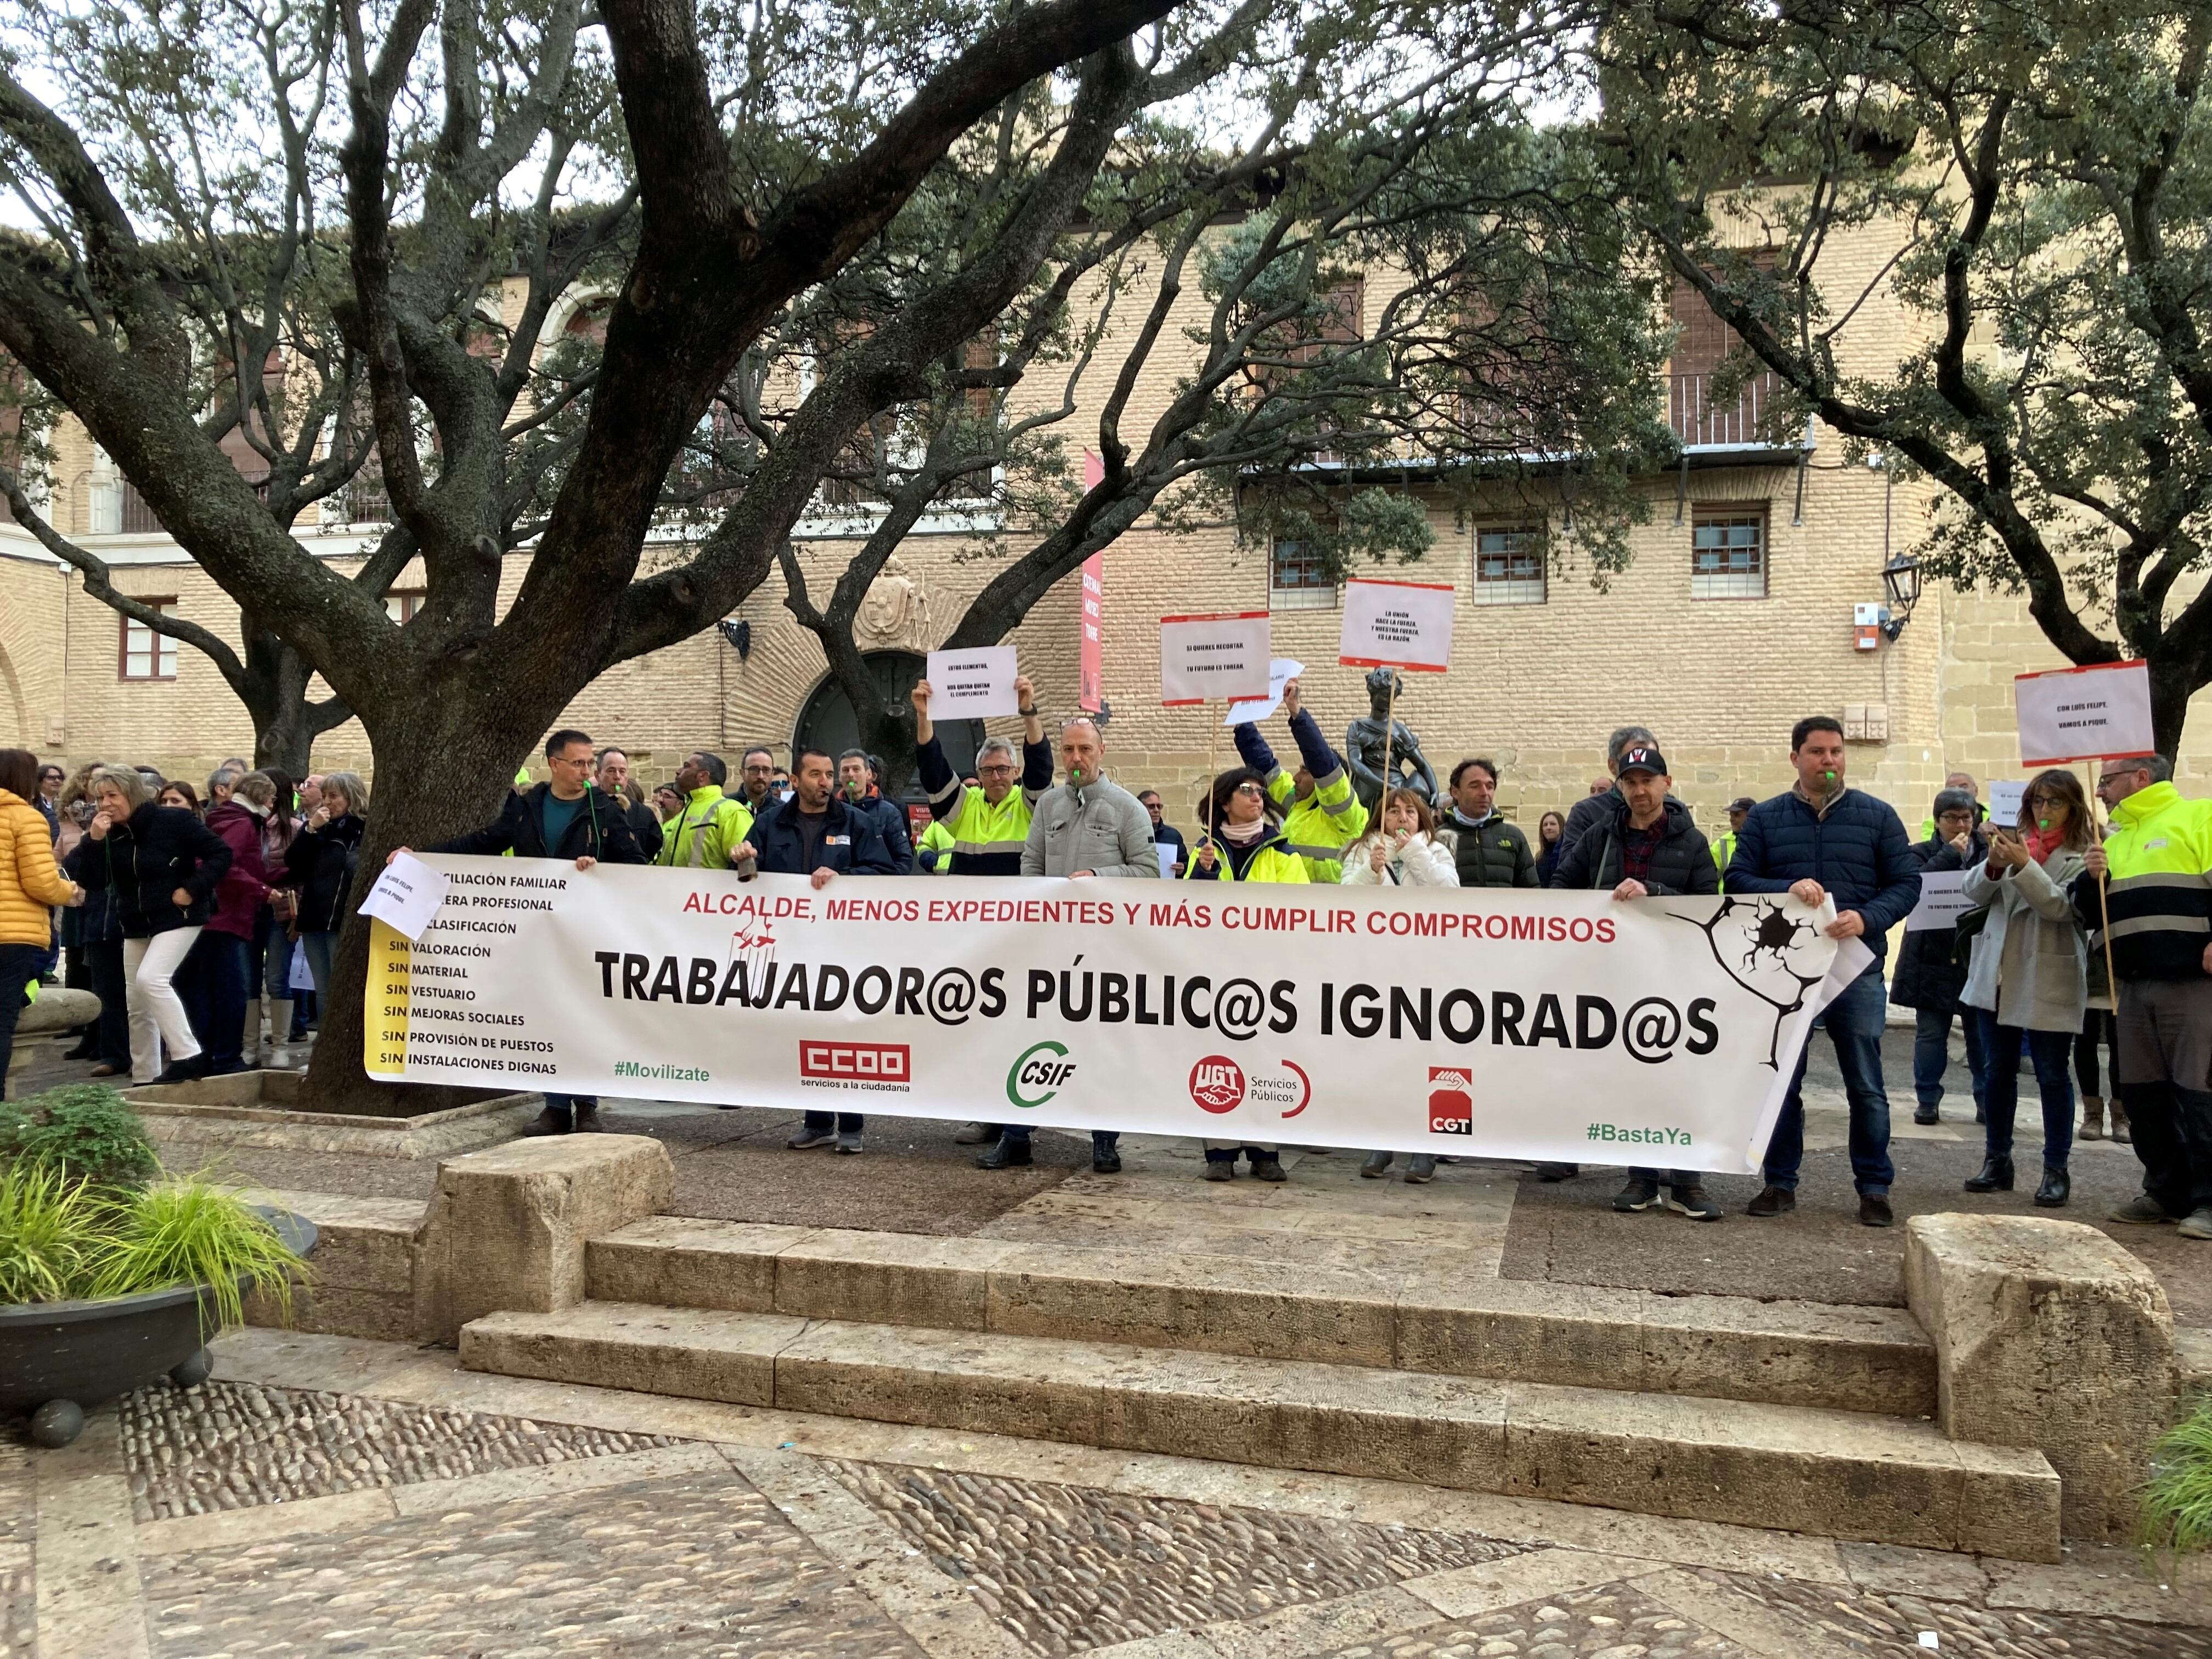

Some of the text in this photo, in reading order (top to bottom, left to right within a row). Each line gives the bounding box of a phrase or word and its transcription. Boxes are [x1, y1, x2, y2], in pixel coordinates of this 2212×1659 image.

[2058, 720, 2081, 729] VAMOS
[510, 876, 567, 890] FAMILIAR
[442, 895, 553, 911] ERA PROFESIONAL
[682, 892, 1616, 944] ALCALDE, MENOS EXPEDIENTES Y MÁS CUMPLIR COMPROMISOS
[389, 940, 490, 957] SIN VALORACIÓN
[388, 962, 468, 978] SIN MATERIAL
[386, 984, 476, 1001] SIN VESTUARIO
[383, 1006, 524, 1026] SIN MEJORAS SOCIALES
[594, 950, 1719, 1064] TRABAJADOR@S PÚBLIC@S IGNORAD@S
[382, 1031, 554, 1053] SIN PROVISIÓN DE PUESTOS
[380, 1053, 556, 1075] SIN INSTALACIONES DIGNAS
[808, 1048, 903, 1074] CCOO
[614, 1061, 710, 1082] #Movilizate
[1020, 1060, 1076, 1087] CSIF
[1197, 1064, 1238, 1088] UGT
[801, 1077, 842, 1088] servicios
[851, 1081, 859, 1089] la
[861, 1080, 910, 1092] ciudadanía
[1251, 1076, 1297, 1090] Servicios
[1251, 1089, 1294, 1102] Públicos
[1432, 1117, 1469, 1132] CGT
[1587, 1123, 1691, 1146] #BastaYa
